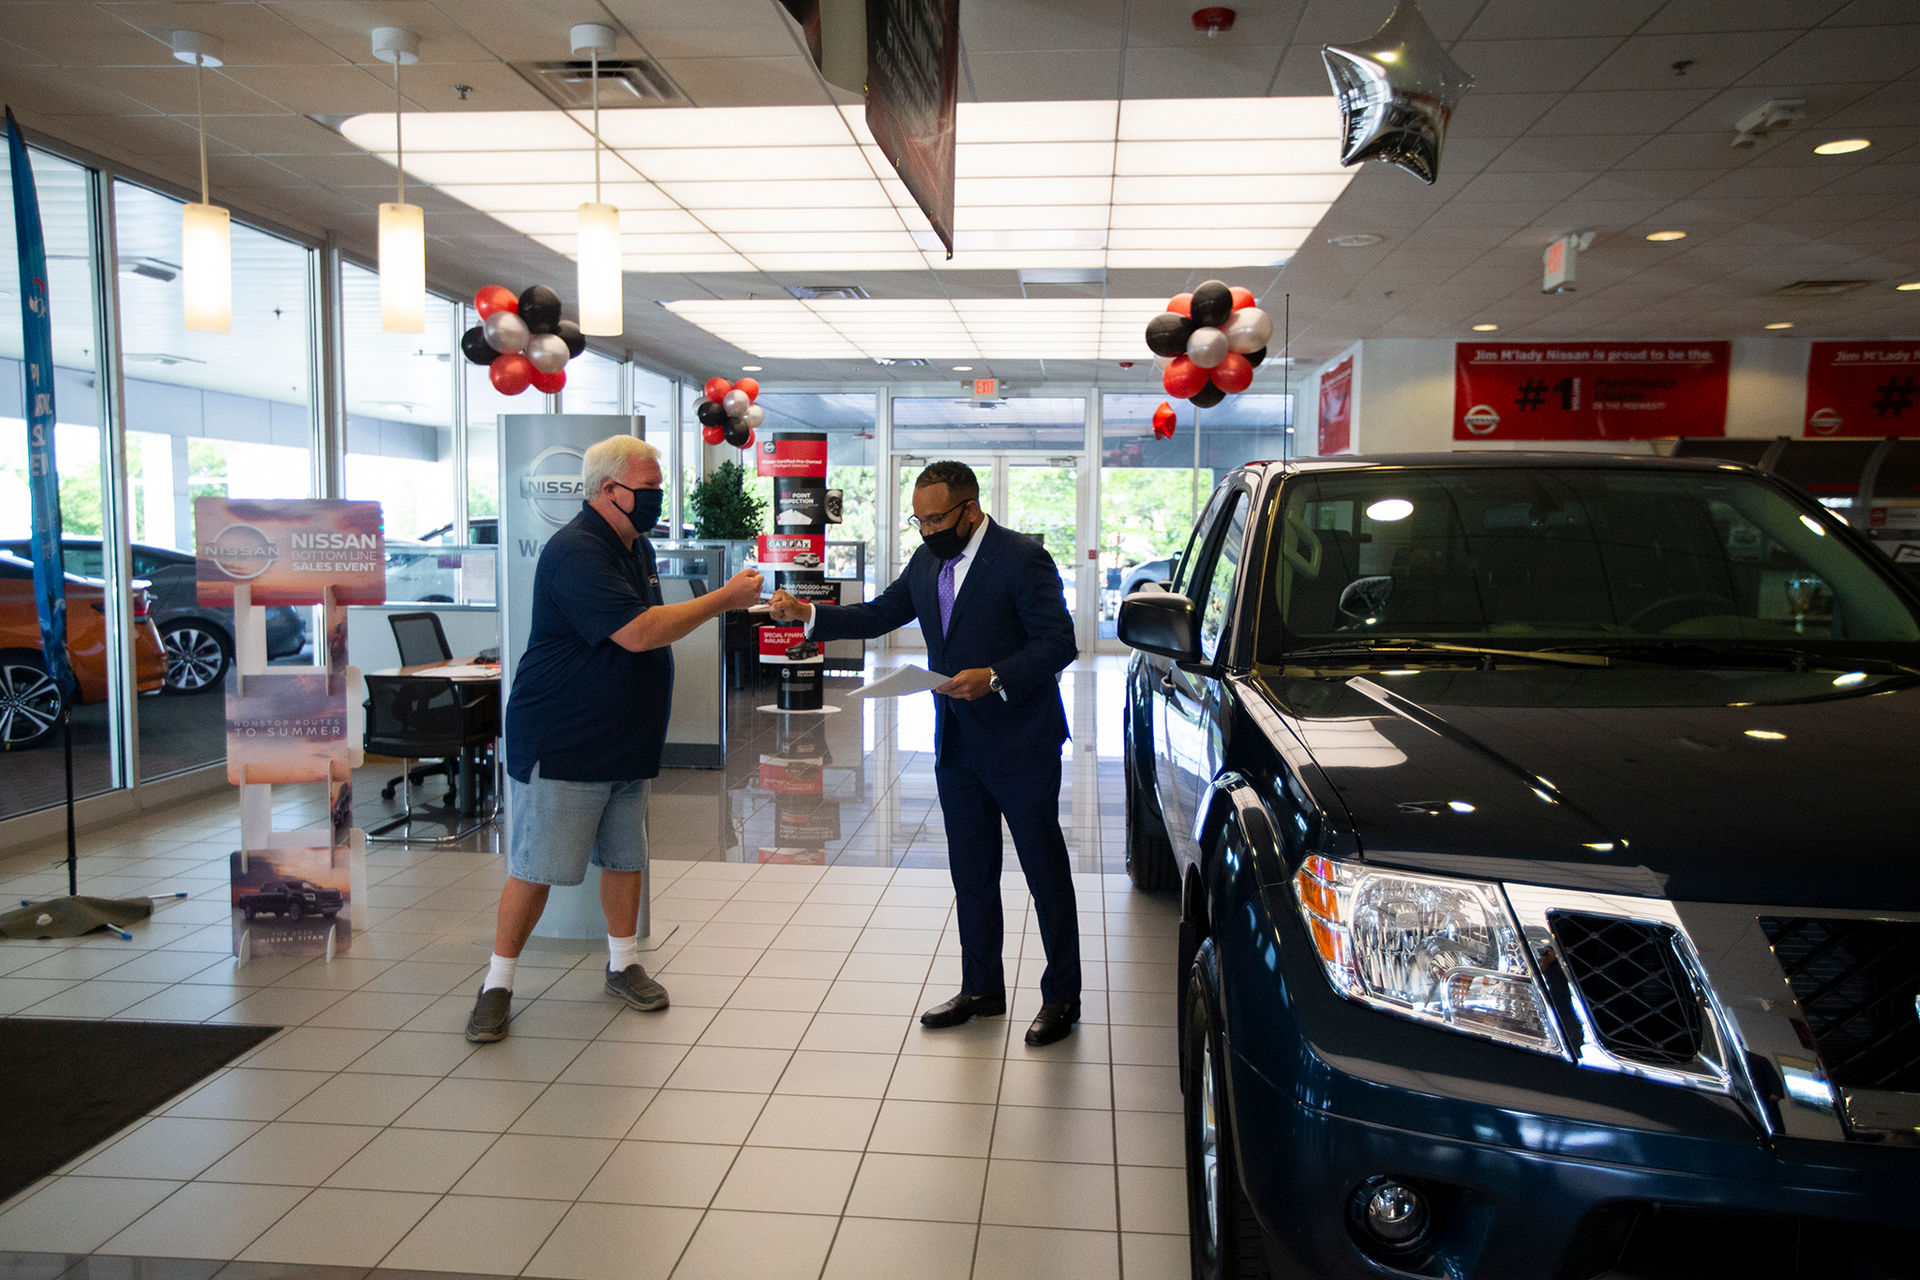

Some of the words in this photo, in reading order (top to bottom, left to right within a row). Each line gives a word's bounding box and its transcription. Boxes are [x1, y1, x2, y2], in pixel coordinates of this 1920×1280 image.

[1474, 349, 1498, 360] Jim
[1546, 349, 1590, 360] Nissan
[1593, 349, 1605, 360] is
[1607, 349, 1648, 362] proud
[1650, 349, 1665, 360] to
[1667, 349, 1685, 360] be
[975, 379, 995, 394] EXIT
[1515, 377, 1573, 411] #1
[528, 481, 584, 494] NISSA
[291, 533, 377, 550] NISSAN
[767, 539, 811, 549] CARFAX
[205, 546, 280, 556] NISSAN
[291, 551, 347, 561] BOTTOM
[349, 551, 377, 561] LINE
[291, 562, 332, 572] SALES
[335, 562, 377, 572] EVENT
[234, 719, 289, 727] NONSTOP
[295, 718, 340, 726] ROUTES
[235, 727, 257, 737] TO
[267, 726, 341, 737] SUMMER
